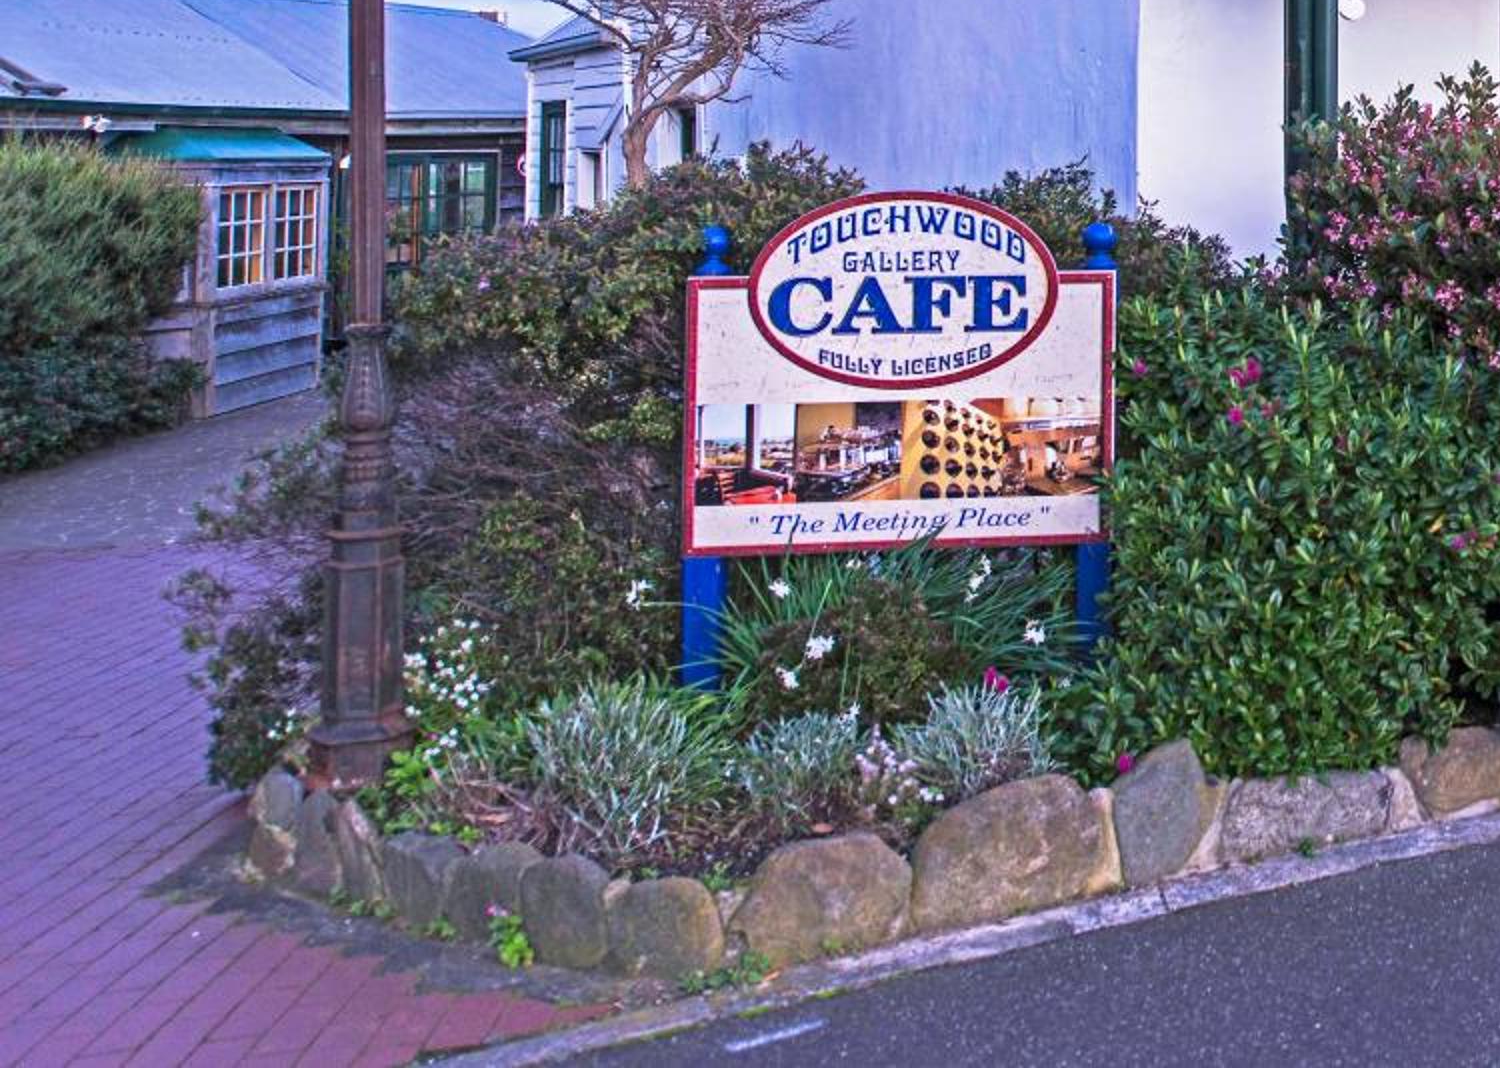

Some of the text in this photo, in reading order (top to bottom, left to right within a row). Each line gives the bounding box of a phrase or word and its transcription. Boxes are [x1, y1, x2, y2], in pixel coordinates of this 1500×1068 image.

[787, 204, 1026, 265] TOUCHWOOD
[843, 250, 961, 273] GALLERY
[767, 275, 1030, 338] CAFE
[818, 342, 992, 376] FULLY LICENSED
[834, 511, 951, 533] Meeting
